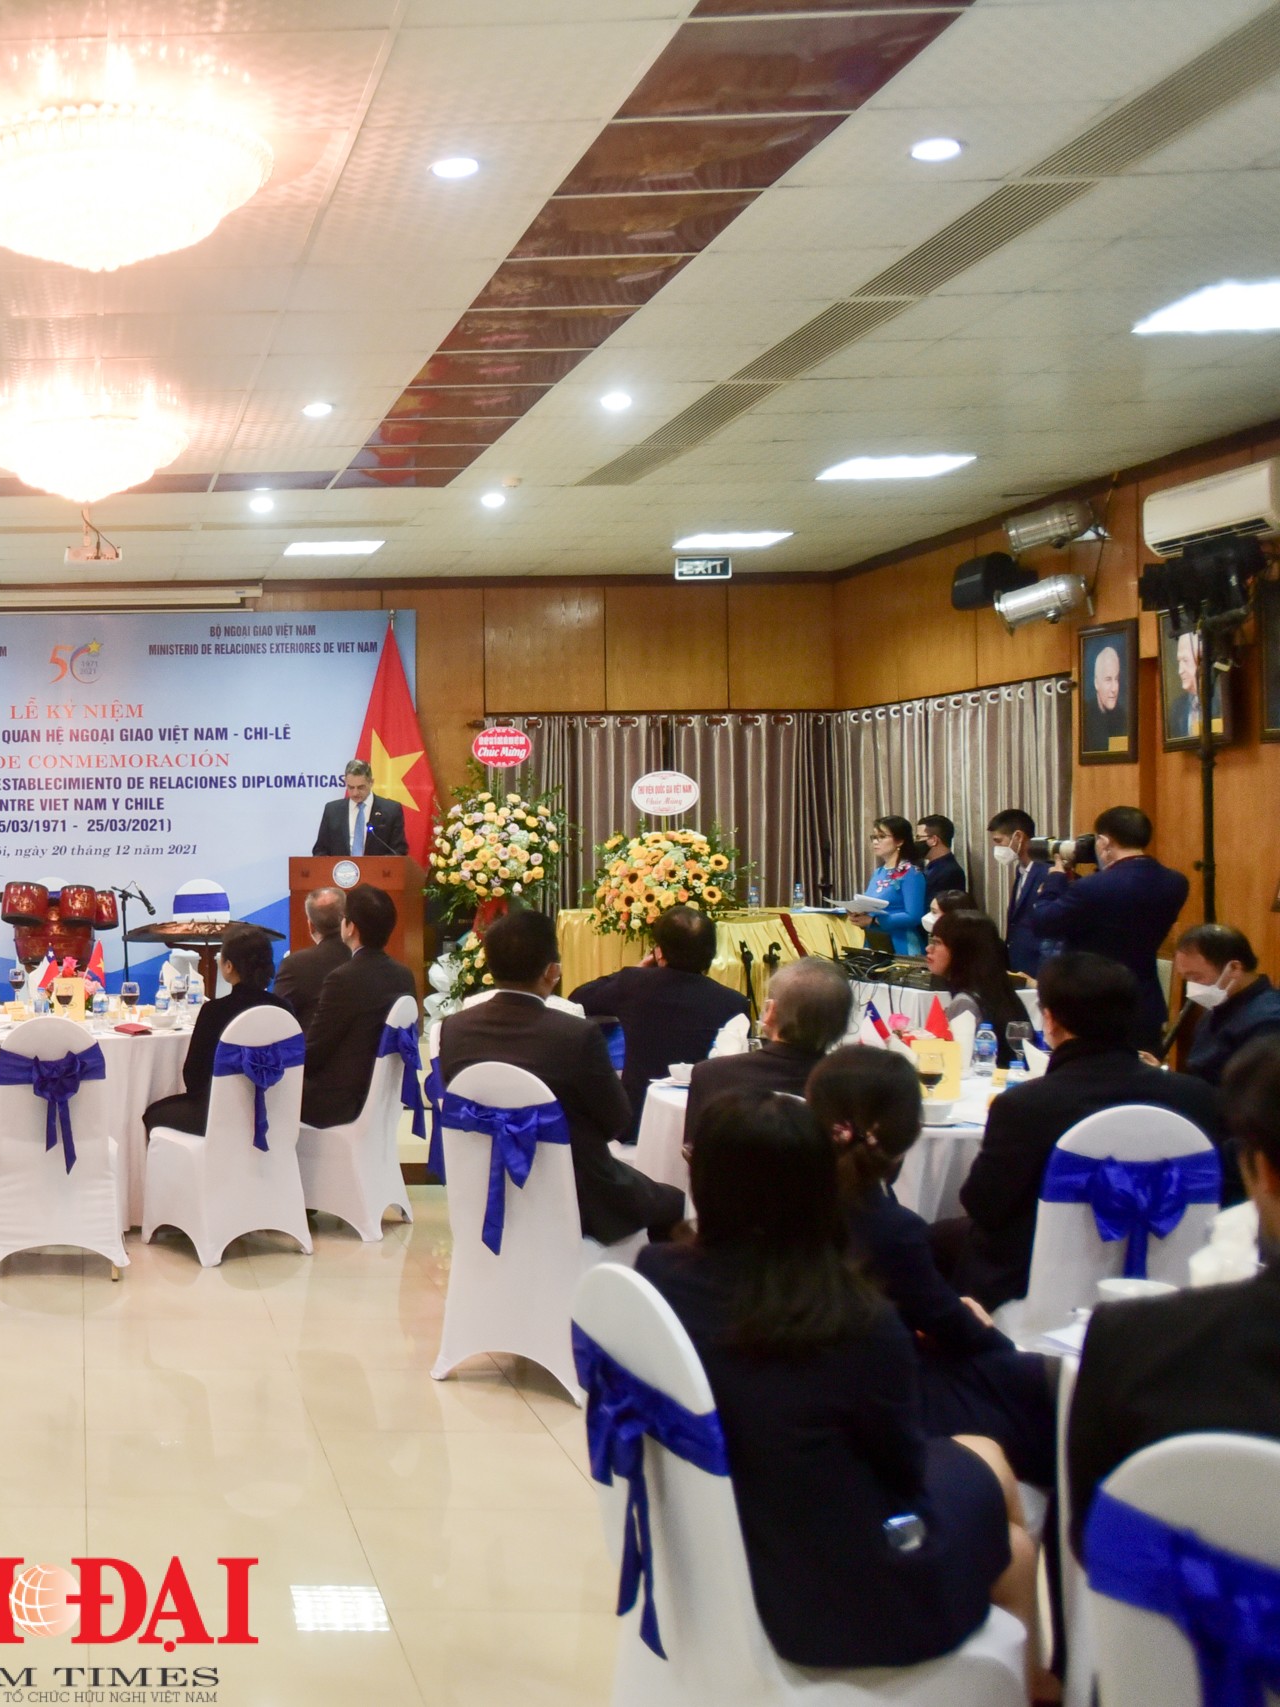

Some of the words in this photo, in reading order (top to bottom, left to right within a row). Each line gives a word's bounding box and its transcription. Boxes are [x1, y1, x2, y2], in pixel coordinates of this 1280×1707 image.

[682, 560, 724, 574] EXIT
[210, 624, 221, 639] BỘ
[224, 626, 250, 639] NGOẠI
[253, 626, 273, 636] GIAO
[276, 623, 293, 638] VIỆT
[296, 625, 316, 636] NAM
[149, 644, 198, 655] MINISTERIO
[202, 644, 212, 654] DE
[215, 643, 267, 654] RELACIONES
[270, 642, 320, 654] EXTERIORES
[324, 642, 334, 653] DE
[337, 642, 354, 653] VIET
[358, 642, 377, 653] NAM
[10, 697, 39, 720] LỄ
[84, 700, 144, 722] NIỆM
[2, 729, 41, 744] QUAN
[46, 726, 64, 745] HỆ
[69, 728, 115, 744] NGOẠI
[120, 728, 154, 741] GIAO
[159, 725, 189, 744] VIỆT
[194, 727, 228, 741] NAM
[244, 724, 291, 740] CHI-LÊ
[28, 748, 230, 769] CONMEMORACIÓN
[127, 777, 144, 789] DE
[150, 776, 237, 789] RELACIONES
[242, 772, 346, 788] DIPLOMÁTICAS
[40, 798, 69, 811] VIET
[74, 798, 107, 811] NAM
[112, 798, 120, 810] Y
[125, 798, 165, 810] CHILE
[87, 819, 171, 832] 25/03/2021)
[15, 846, 48, 858] ngày
[52, 846, 67, 856] 20
[71, 845, 111, 857] tháng
[115, 845, 130, 855] 12
[134, 845, 164, 855] năm
[168, 844, 197, 855] 2021
